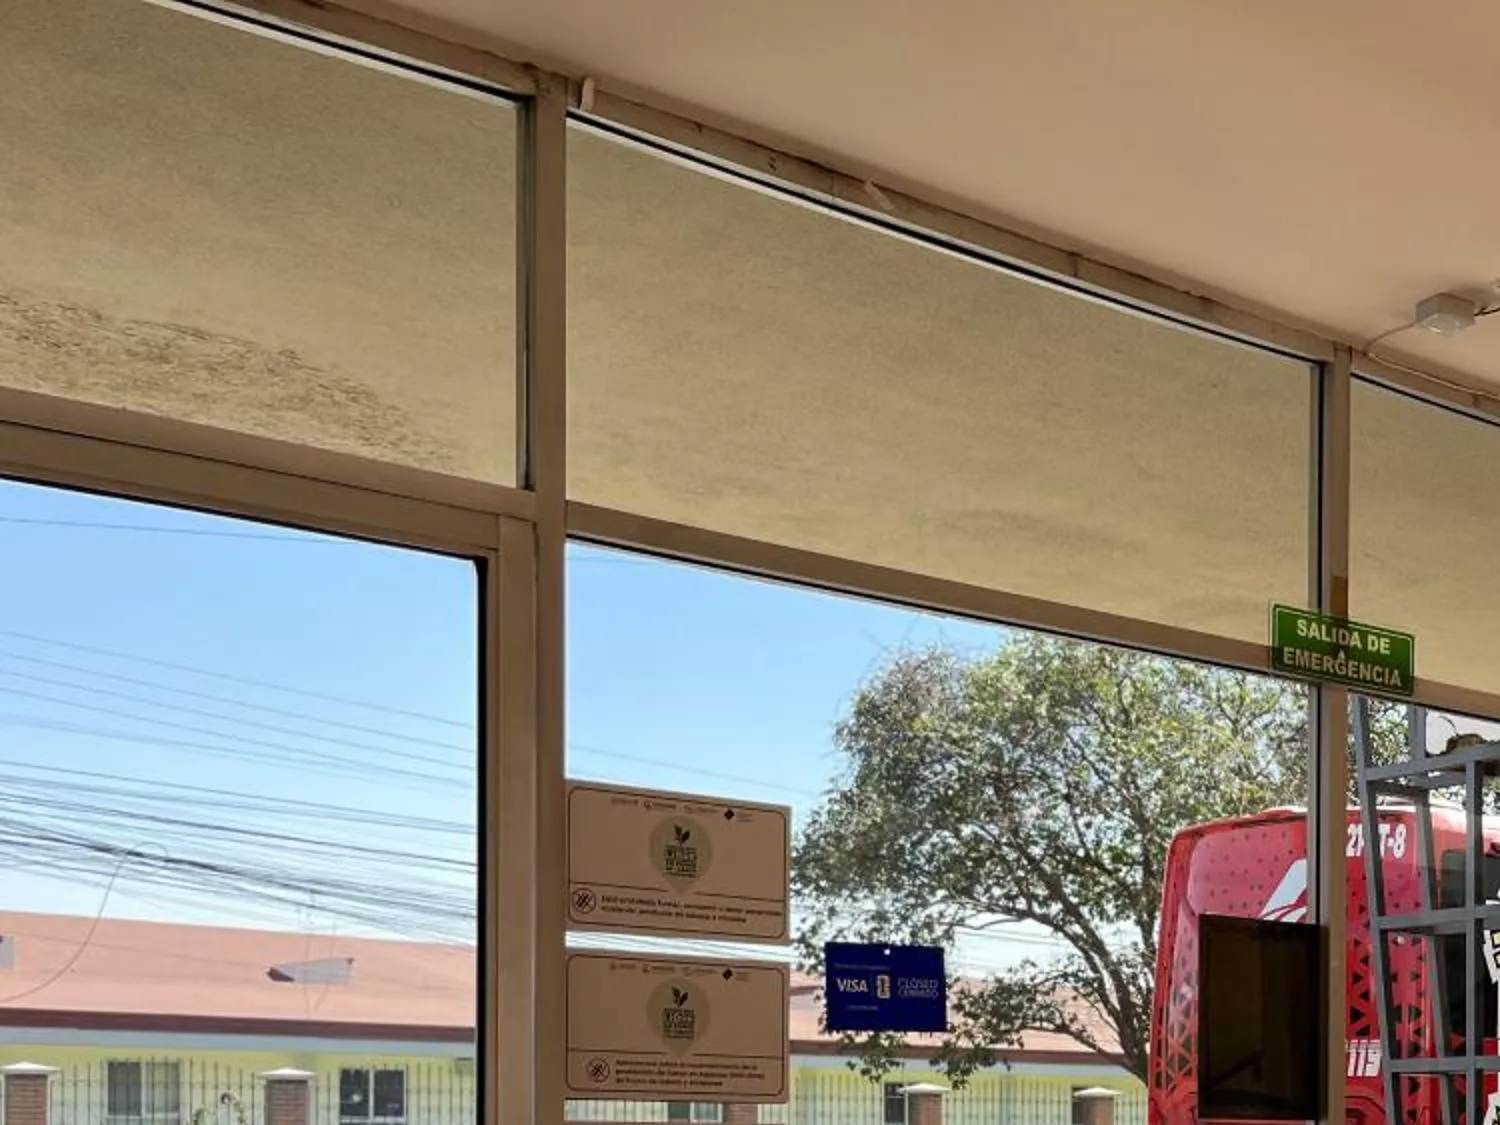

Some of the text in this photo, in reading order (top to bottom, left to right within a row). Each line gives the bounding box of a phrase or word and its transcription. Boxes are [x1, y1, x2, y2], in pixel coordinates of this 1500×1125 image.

[1297, 619, 1391, 654] SALIDA DE
[1283, 647, 1402, 686] EMERGENCIA
[835, 977, 869, 993] VISA
